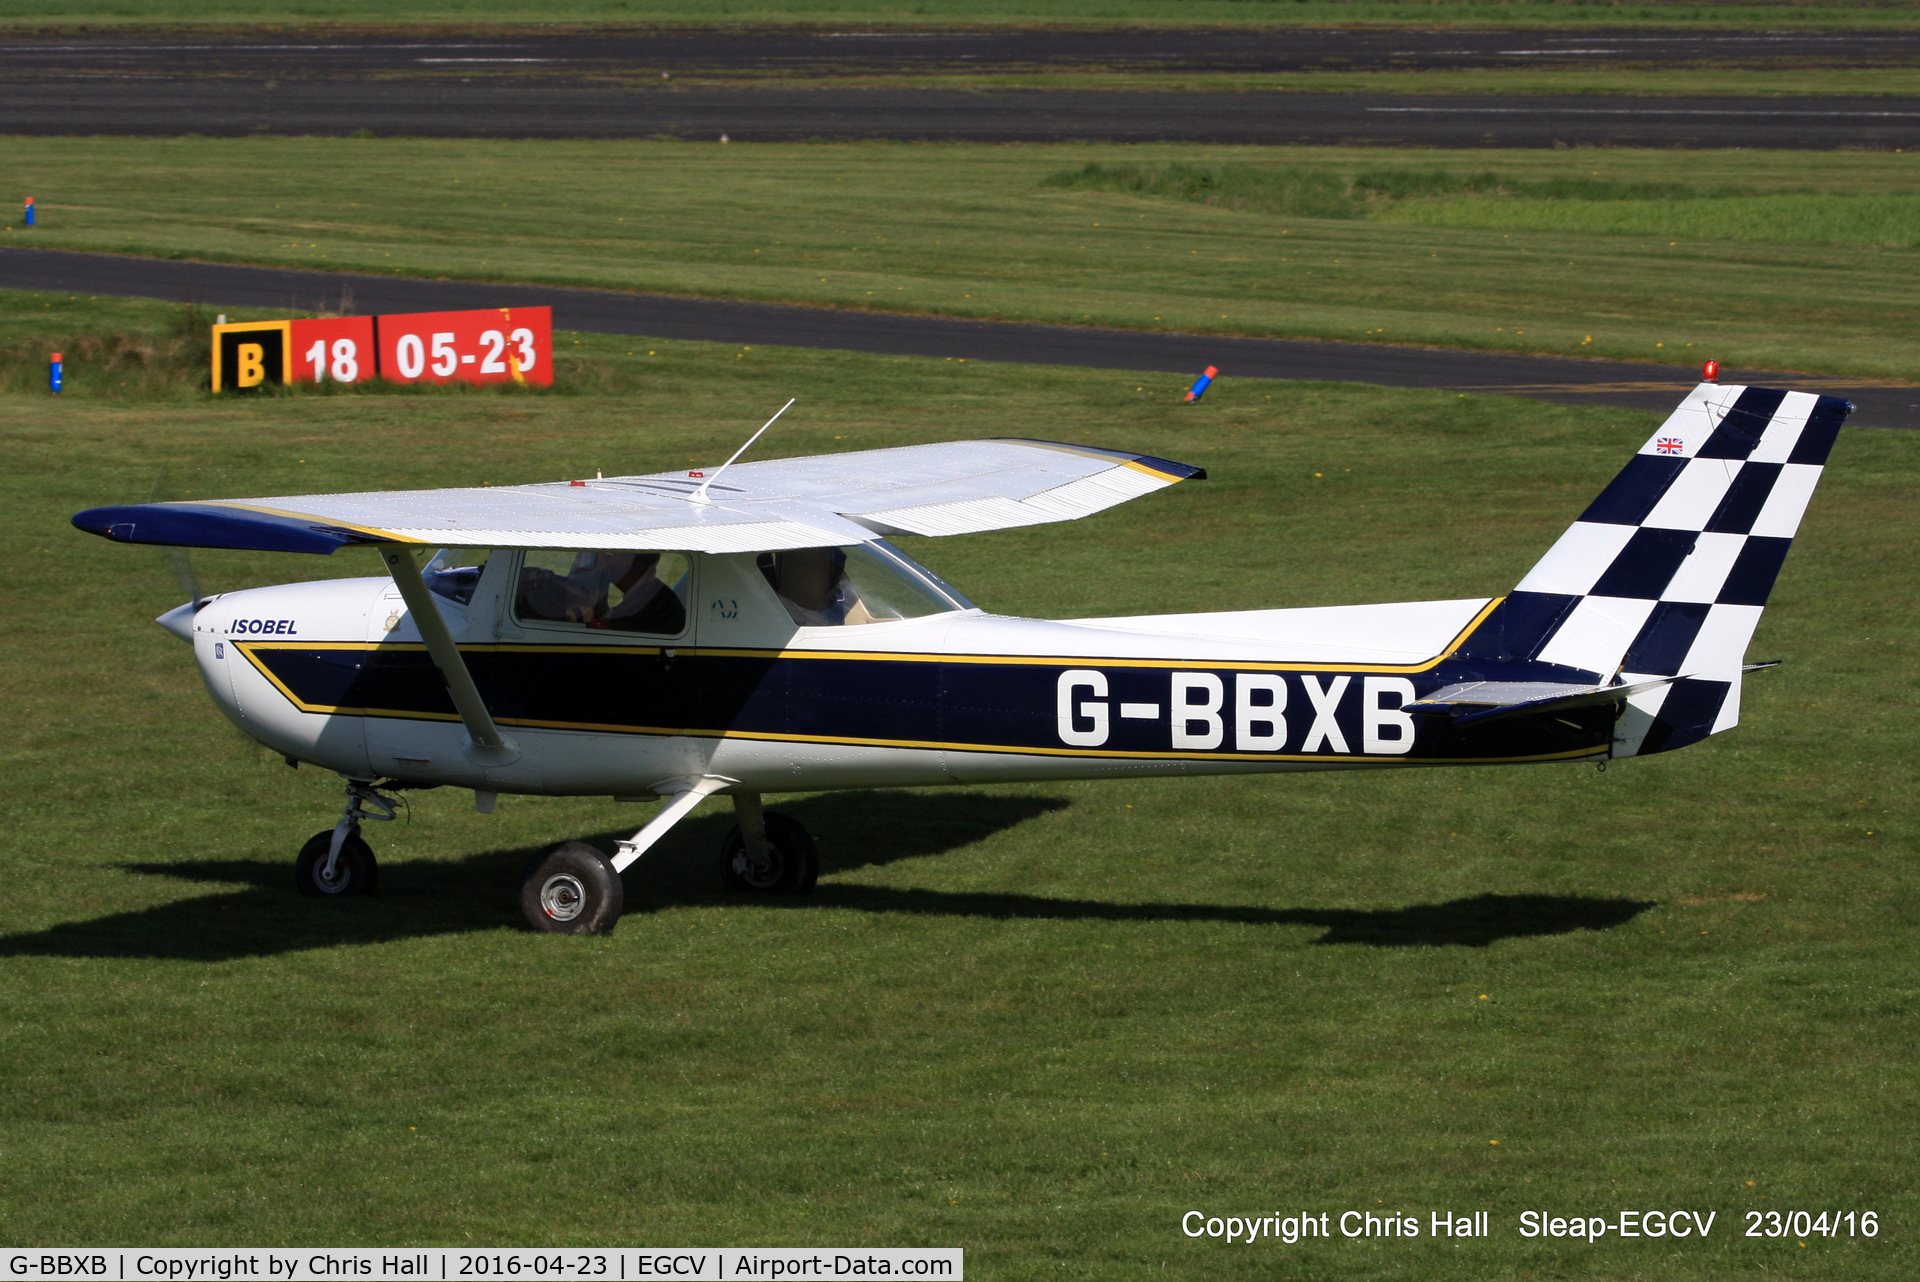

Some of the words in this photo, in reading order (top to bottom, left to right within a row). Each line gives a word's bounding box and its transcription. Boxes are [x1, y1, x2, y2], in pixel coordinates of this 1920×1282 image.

[238, 342, 265, 388] B
[305, 338, 359, 383] 18
[396, 327, 536, 379] 05-23
[230, 619, 298, 635] ISOBEL
[1057, 669, 1417, 755] G-BBXB
